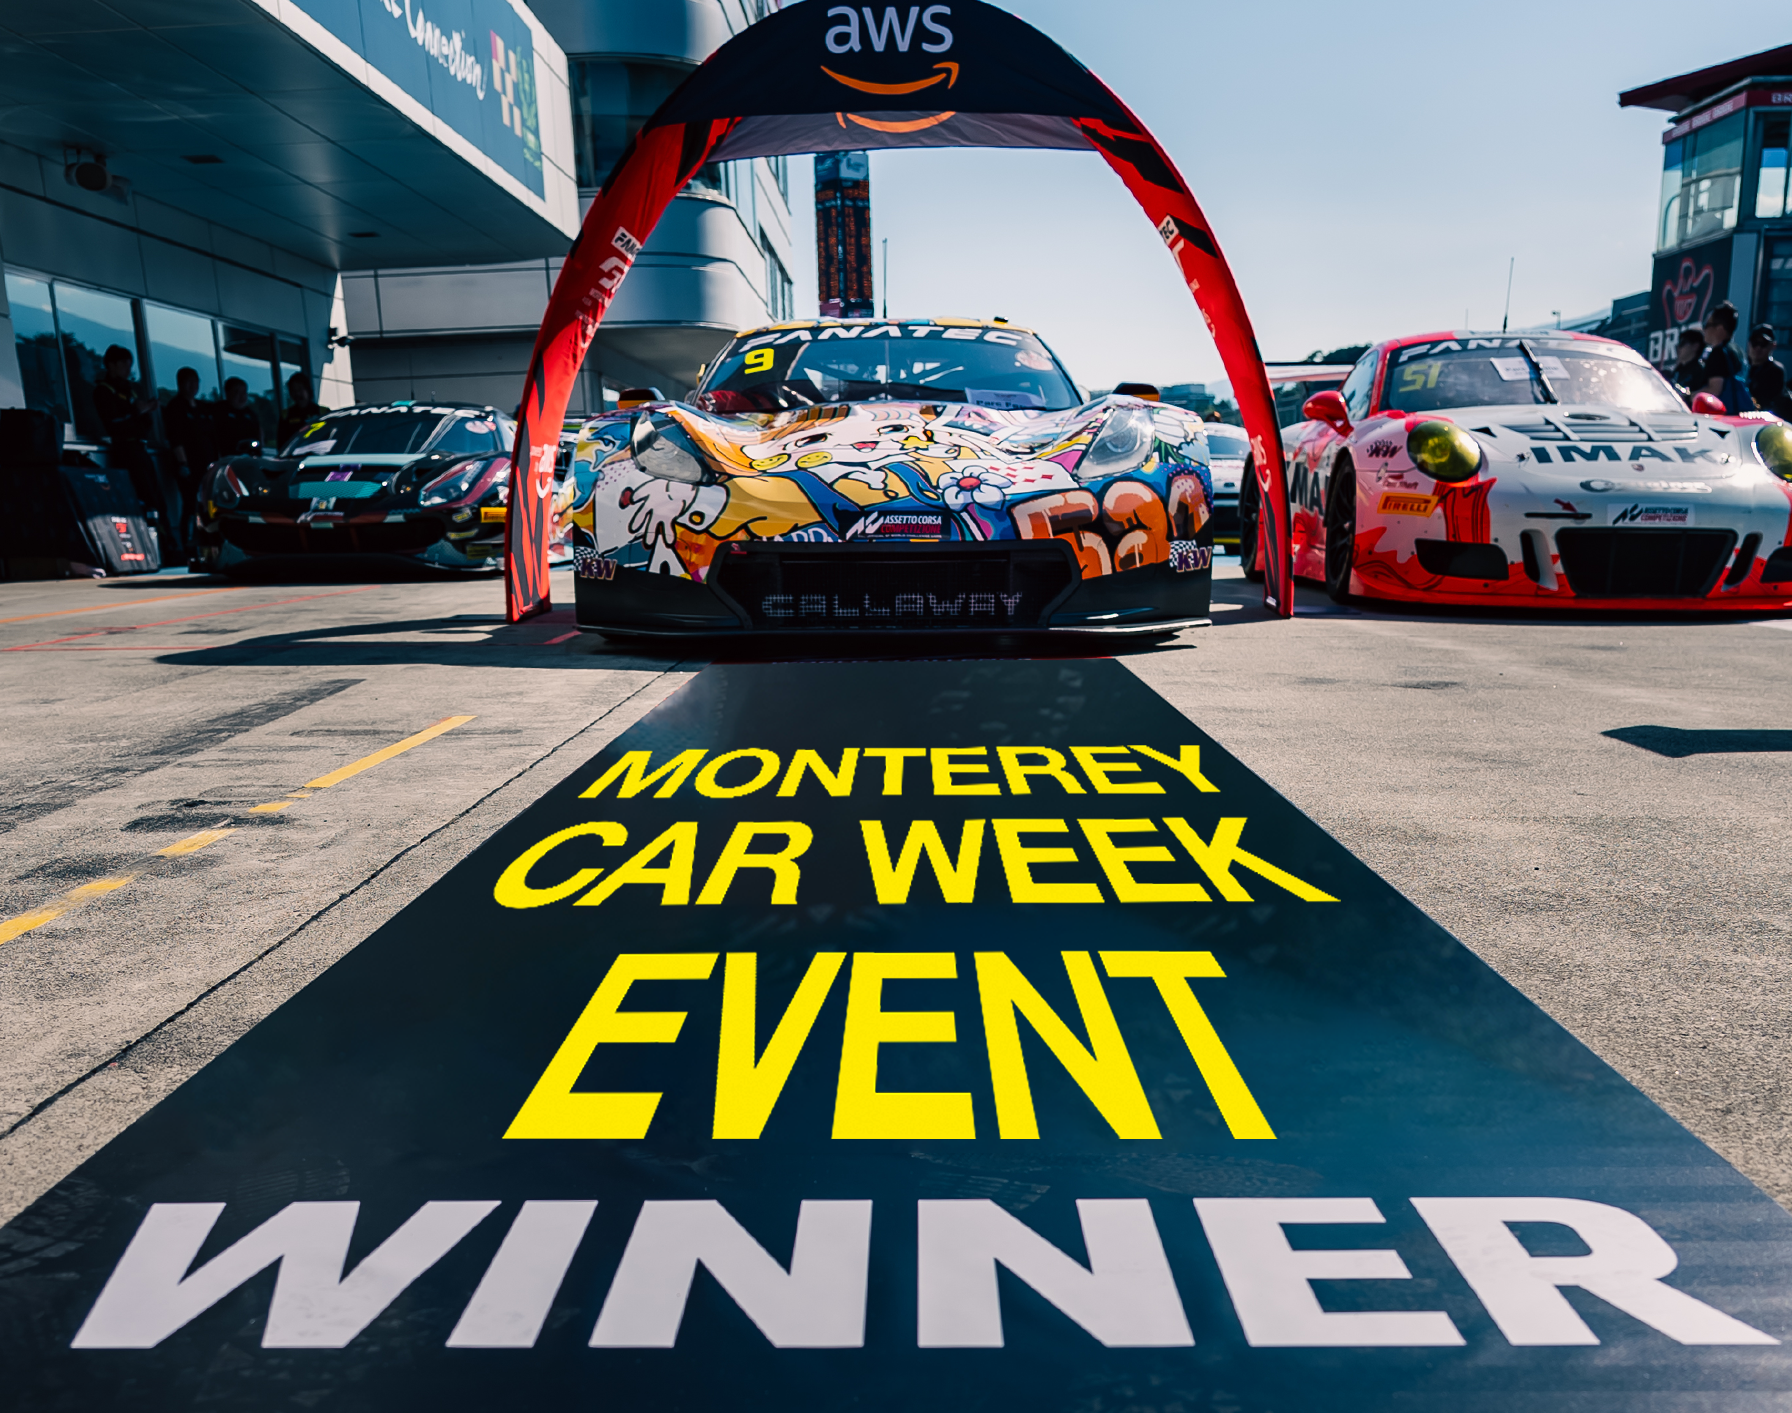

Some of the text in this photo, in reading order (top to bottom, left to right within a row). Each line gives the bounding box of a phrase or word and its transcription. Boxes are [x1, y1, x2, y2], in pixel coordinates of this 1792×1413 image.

[825, 5, 954, 53] aws
[738, 325, 1023, 353] FANATEC
[744, 348, 775, 375] 9
[1398, 362, 1441, 393] 51
[1382, 496, 1432, 512] PIRELLI
[880, 524, 941, 534] COMPETIZIONE
[884, 515, 942, 524] ASSETTO CORSA
[580, 557, 618, 580] KW
[1176, 547, 1213, 573] KW
[761, 593, 1022, 617] CALLAWAY
[578, 745, 1221, 799] MONTEREY
[494, 817, 1341, 909] CAR WEEK
[502, 950, 1278, 1140] EVENT
[70, 1196, 1782, 1349] WINNER
